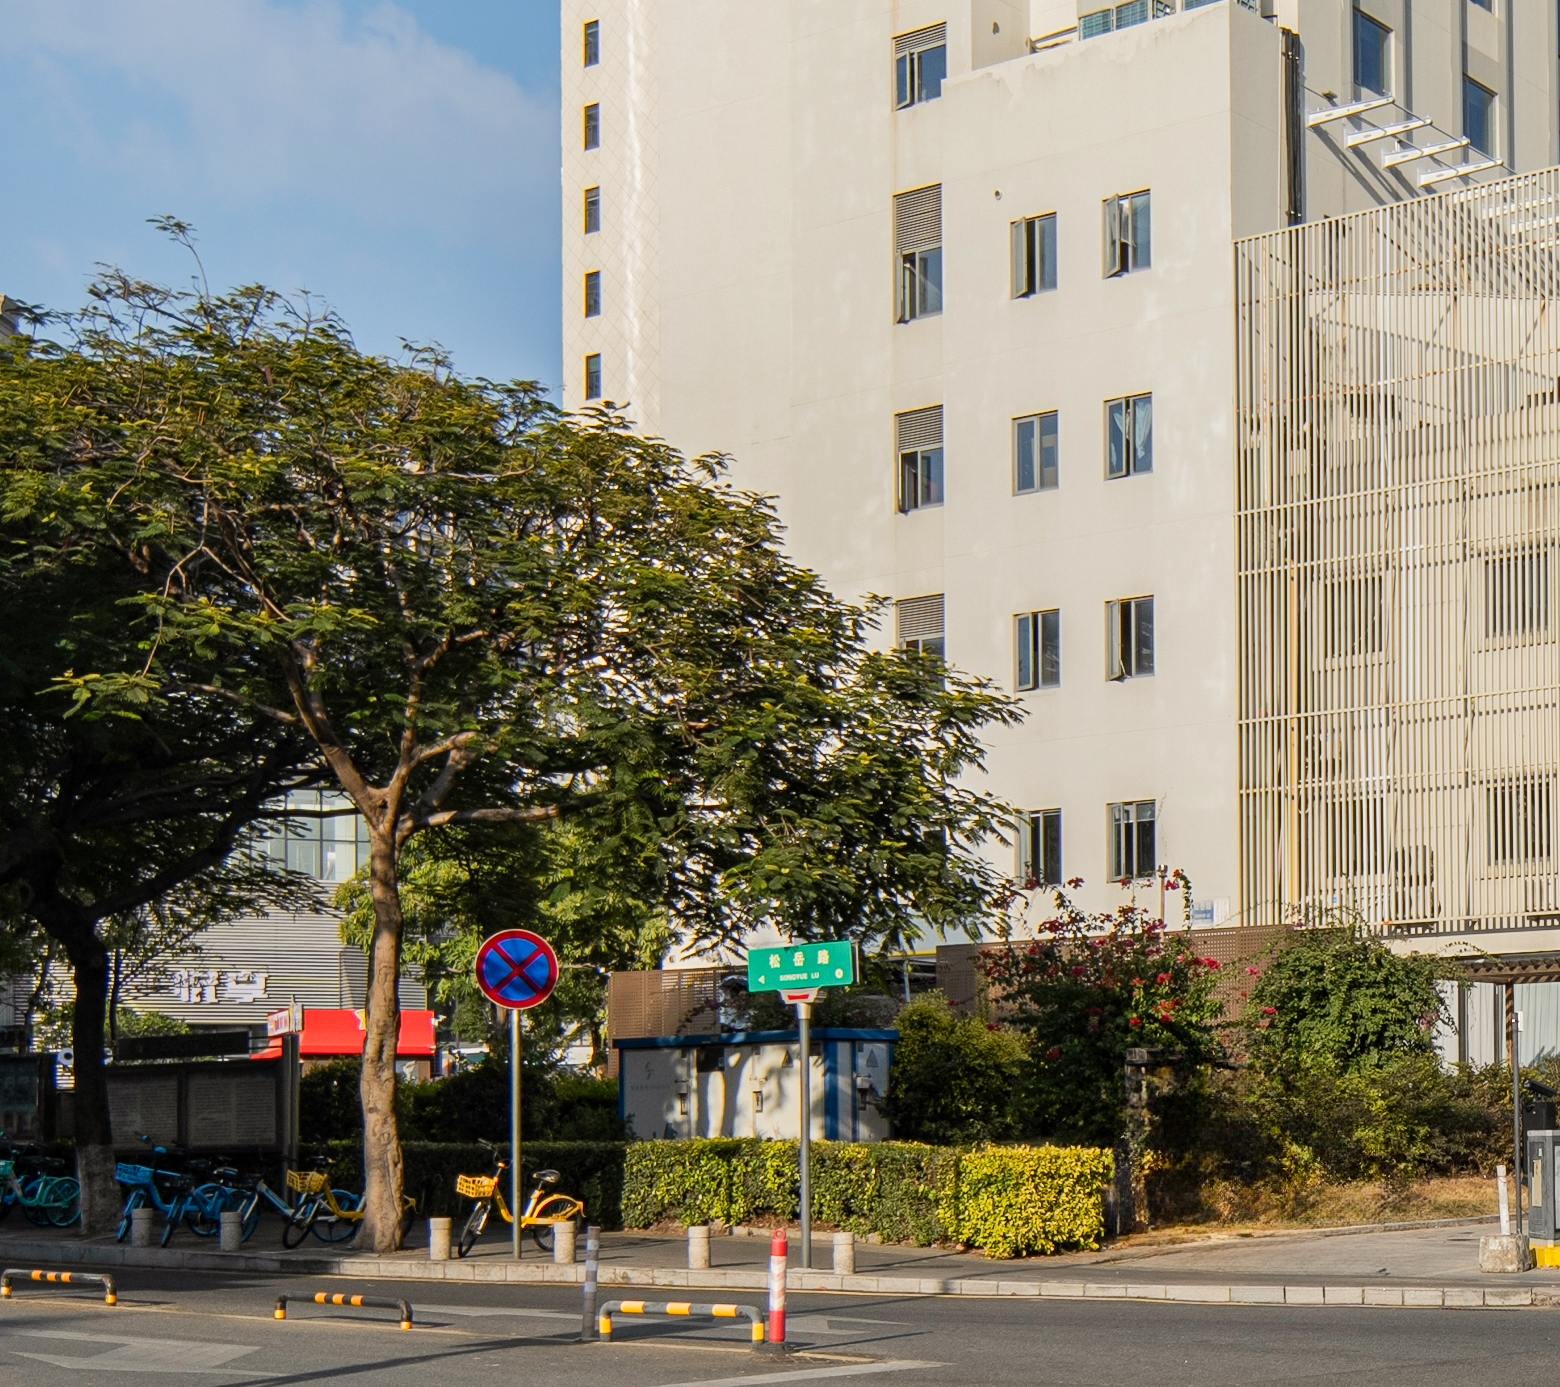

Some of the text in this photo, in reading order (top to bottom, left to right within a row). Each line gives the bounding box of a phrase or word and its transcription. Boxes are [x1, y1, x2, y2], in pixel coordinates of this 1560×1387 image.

[768, 948, 830, 969] 松岳路
[779, 971, 820, 982] SONGYUE LU
